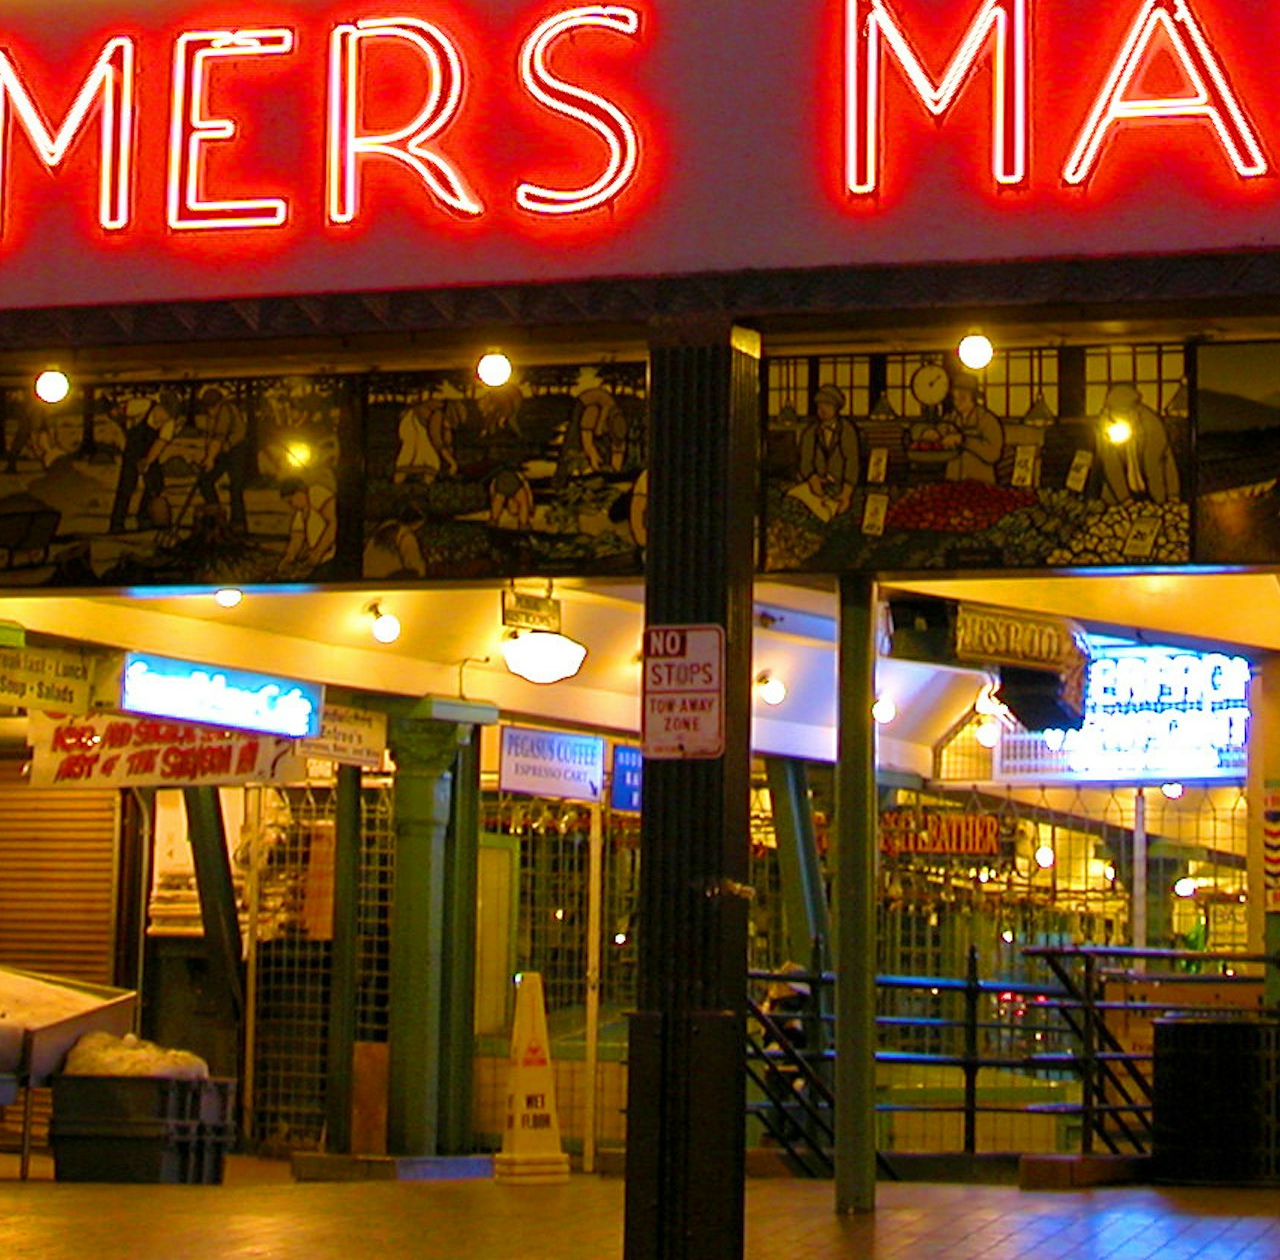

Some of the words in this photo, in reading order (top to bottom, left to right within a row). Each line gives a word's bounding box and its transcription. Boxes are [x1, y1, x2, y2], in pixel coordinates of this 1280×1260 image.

[650, 632, 680, 655] NO
[55, 659, 88, 682] Lunch
[651, 664, 713, 687] STOPS
[0, 674, 27, 699] Soup
[37, 681, 74, 704] Salads
[664, 717, 700, 733] ZONE
[507, 733, 554, 761] PEGASUS
[556, 737, 597, 766] COFFEE
[515, 762, 562, 780] ESPRESSO
[563, 767, 588, 782] CART
